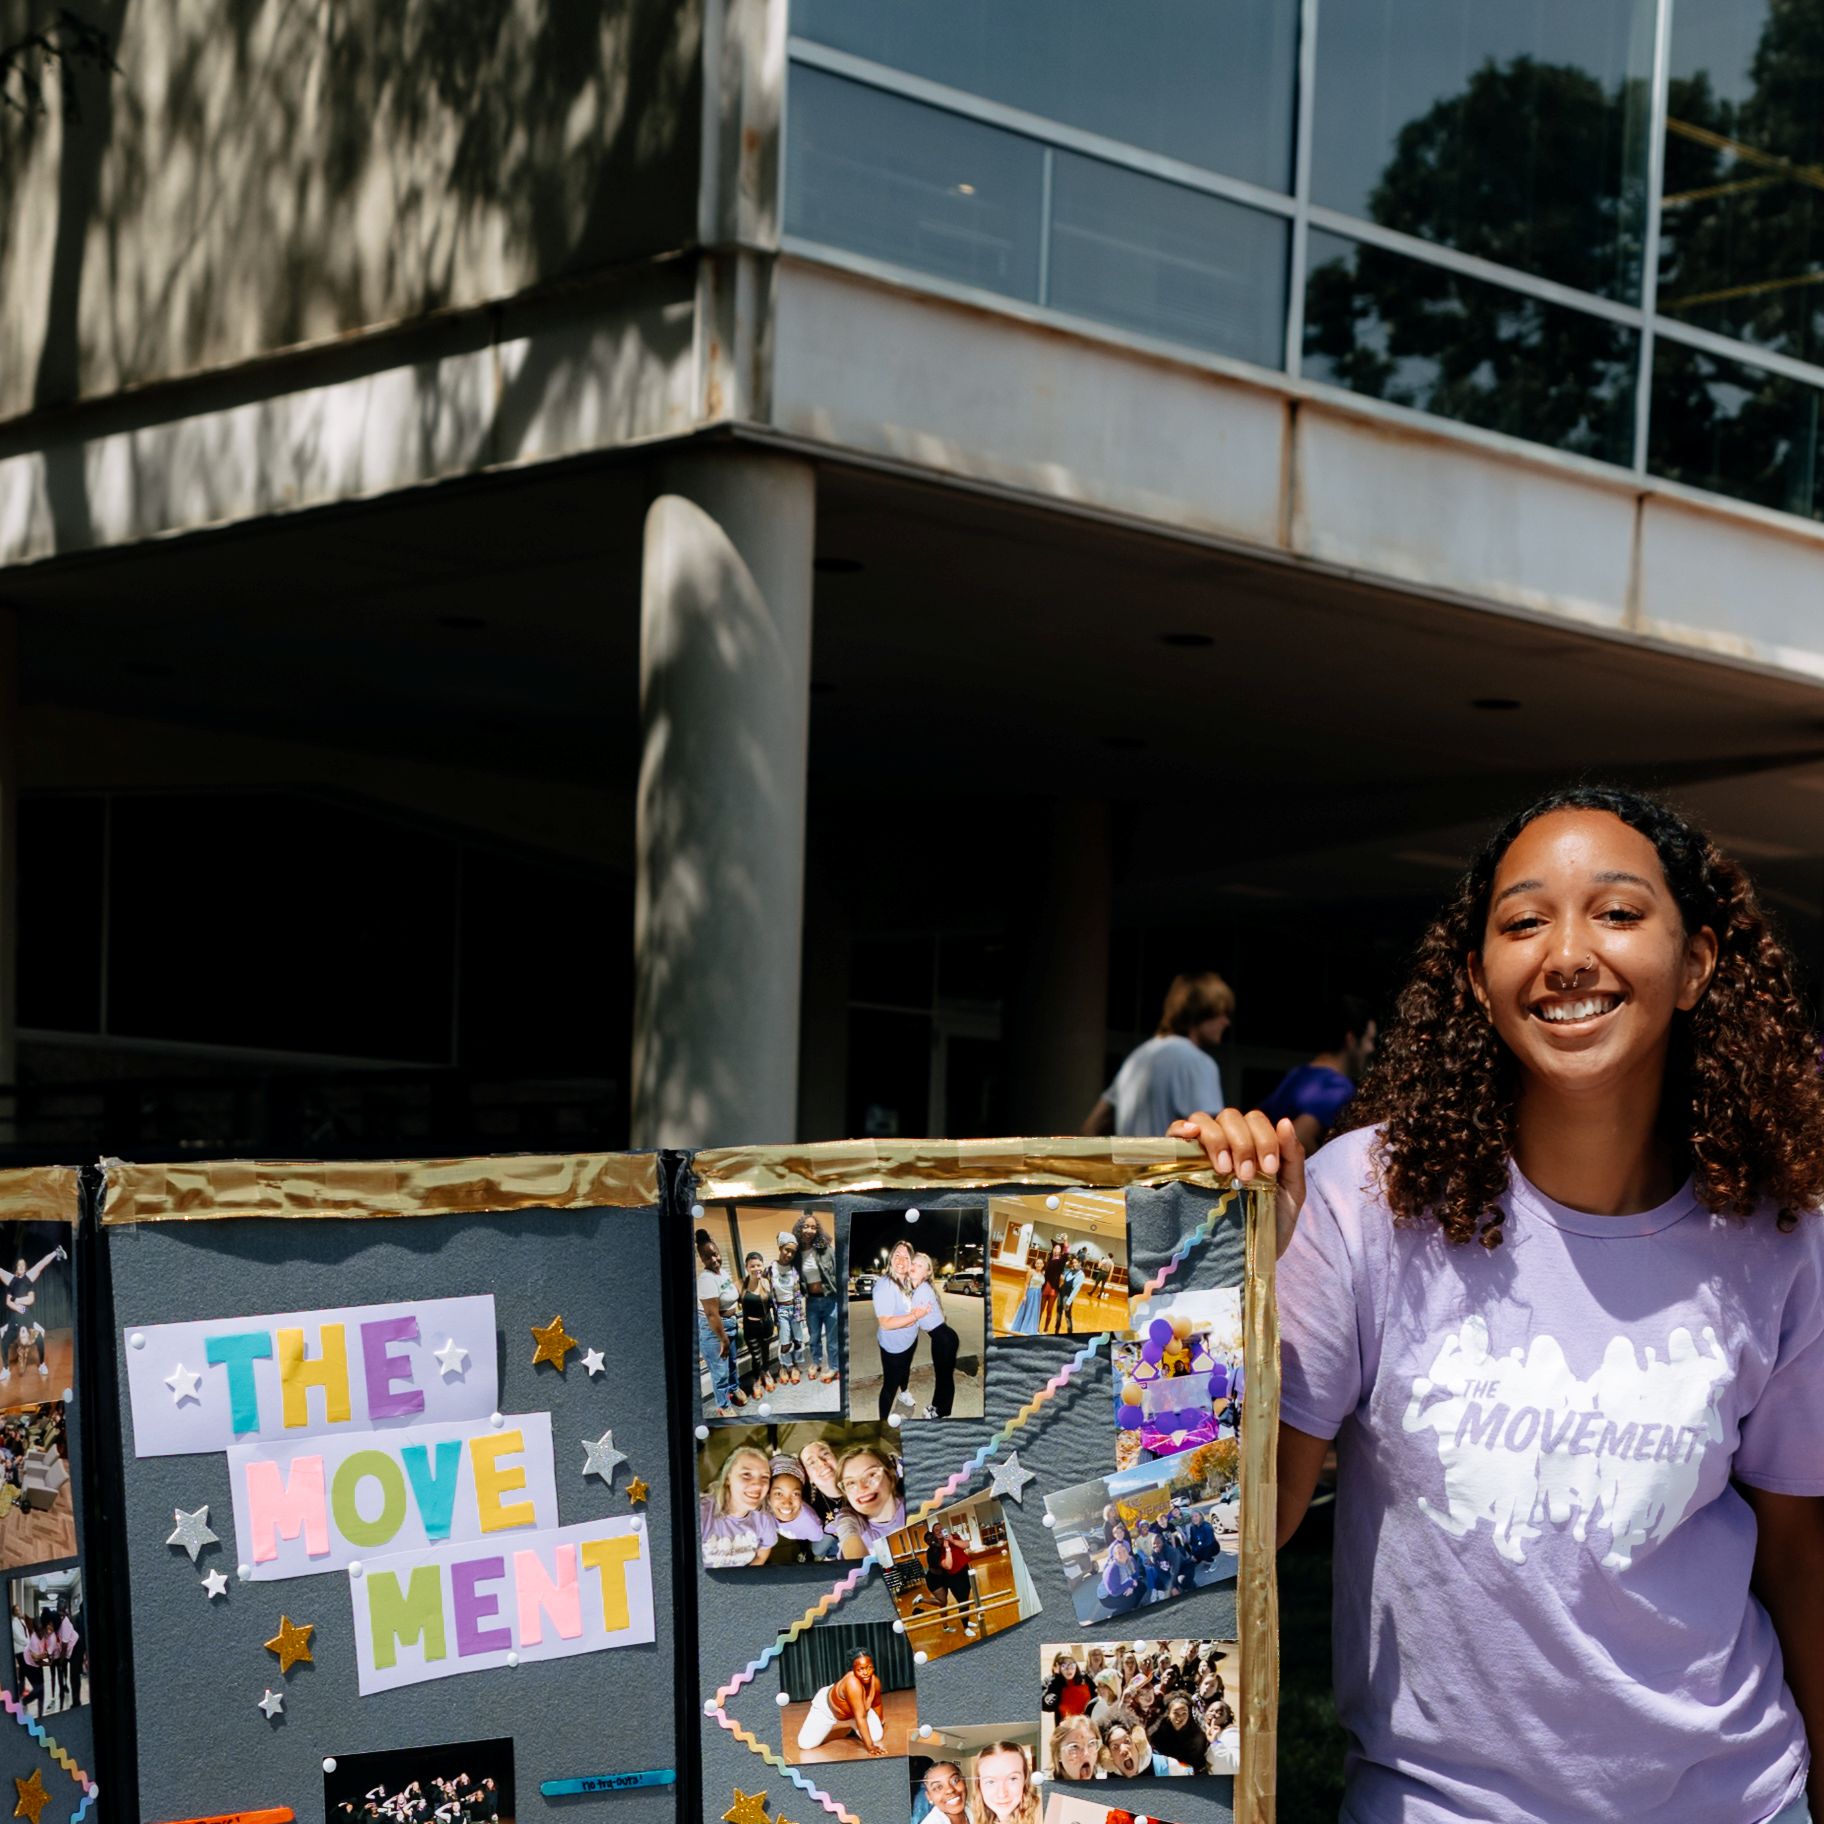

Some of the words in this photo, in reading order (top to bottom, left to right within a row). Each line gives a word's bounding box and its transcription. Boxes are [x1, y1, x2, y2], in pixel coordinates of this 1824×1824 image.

[203, 1315, 426, 1435] THE
[1453, 1401, 1709, 1465] MOVEMENT
[1462, 1378, 1501, 1400] THE
[245, 1429, 536, 1563] MOVE
[365, 1533, 642, 1670] MENT
